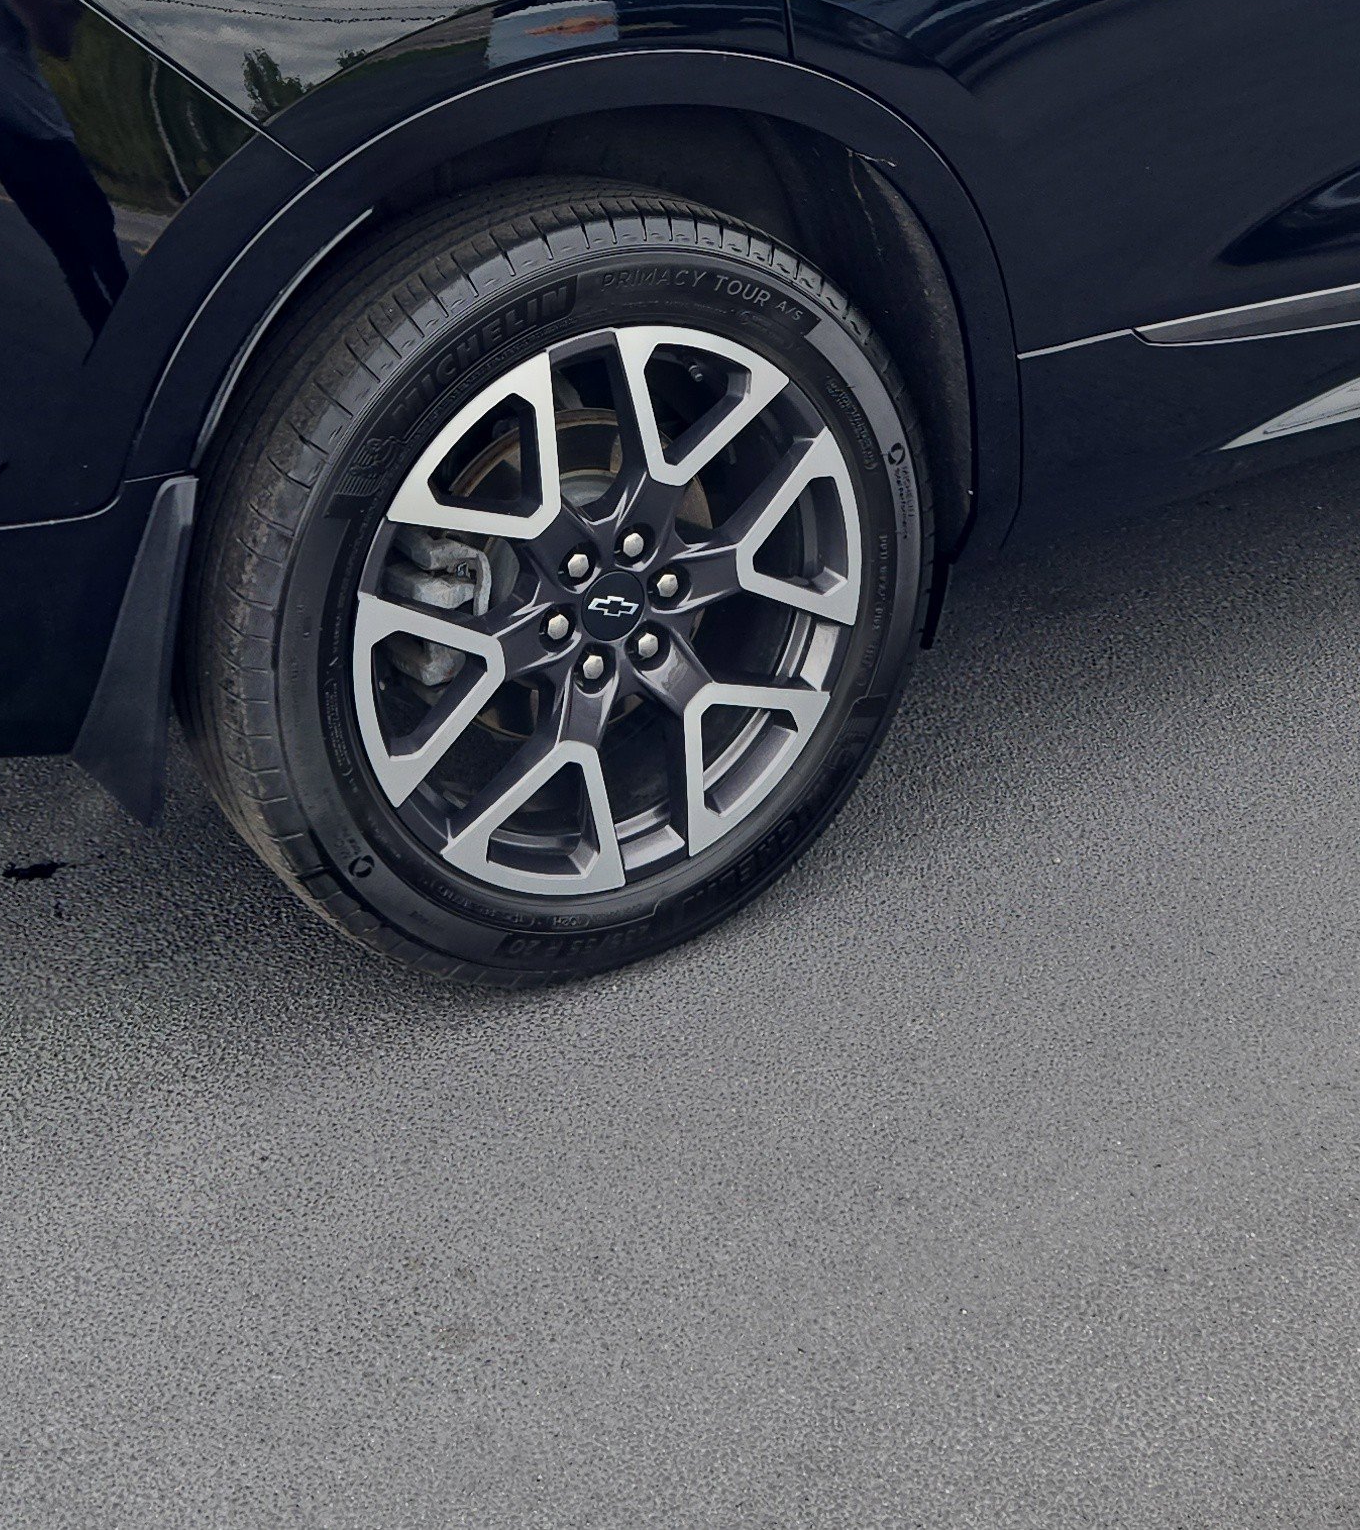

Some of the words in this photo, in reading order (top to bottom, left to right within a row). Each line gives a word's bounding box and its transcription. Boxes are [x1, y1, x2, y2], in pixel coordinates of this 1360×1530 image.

[601, 268, 708, 293] PRIMACY
[713, 274, 771, 308] TOUR
[776, 299, 804, 321] A/S
[390, 284, 570, 428] MICHELIN
